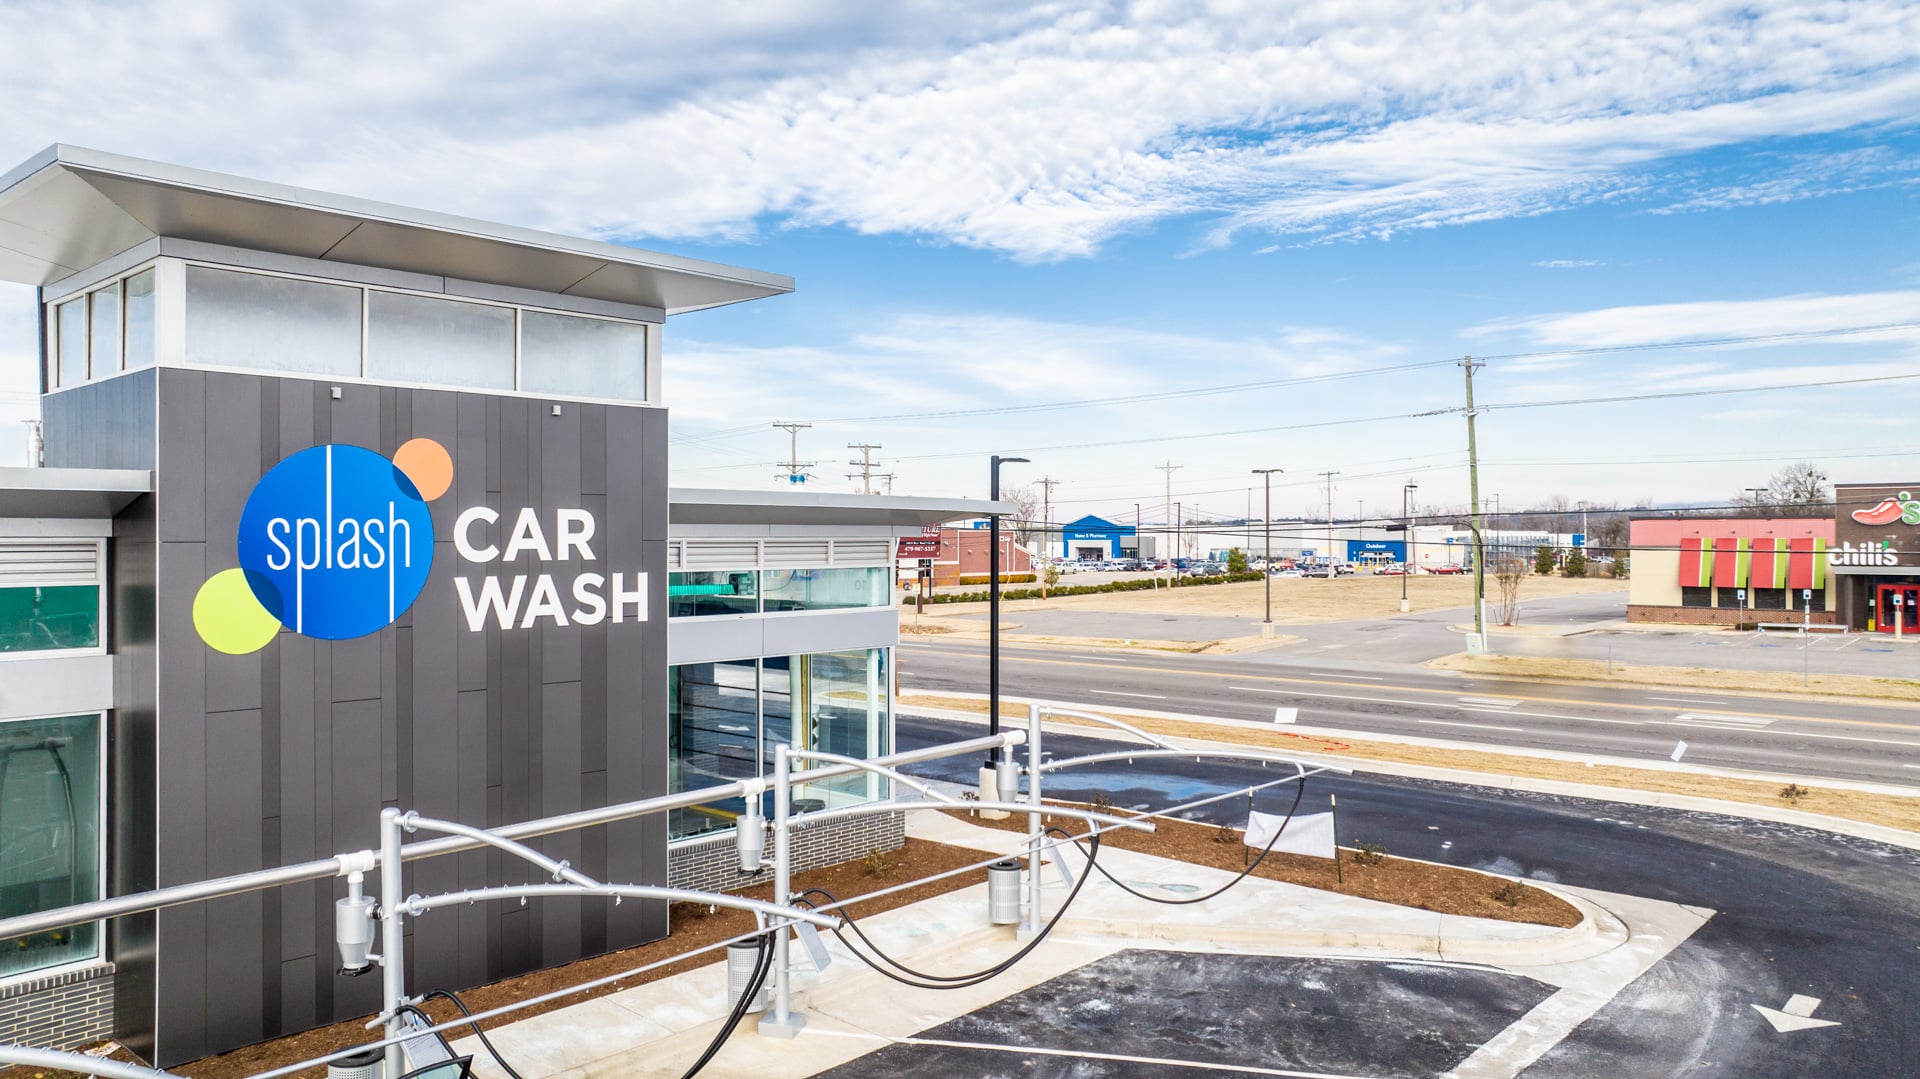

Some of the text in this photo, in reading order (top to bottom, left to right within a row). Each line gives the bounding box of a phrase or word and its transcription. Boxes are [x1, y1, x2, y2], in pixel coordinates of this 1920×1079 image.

[266, 445, 411, 634] splash
[453, 506, 596, 562] CAR
[454, 572, 649, 632] WASH
